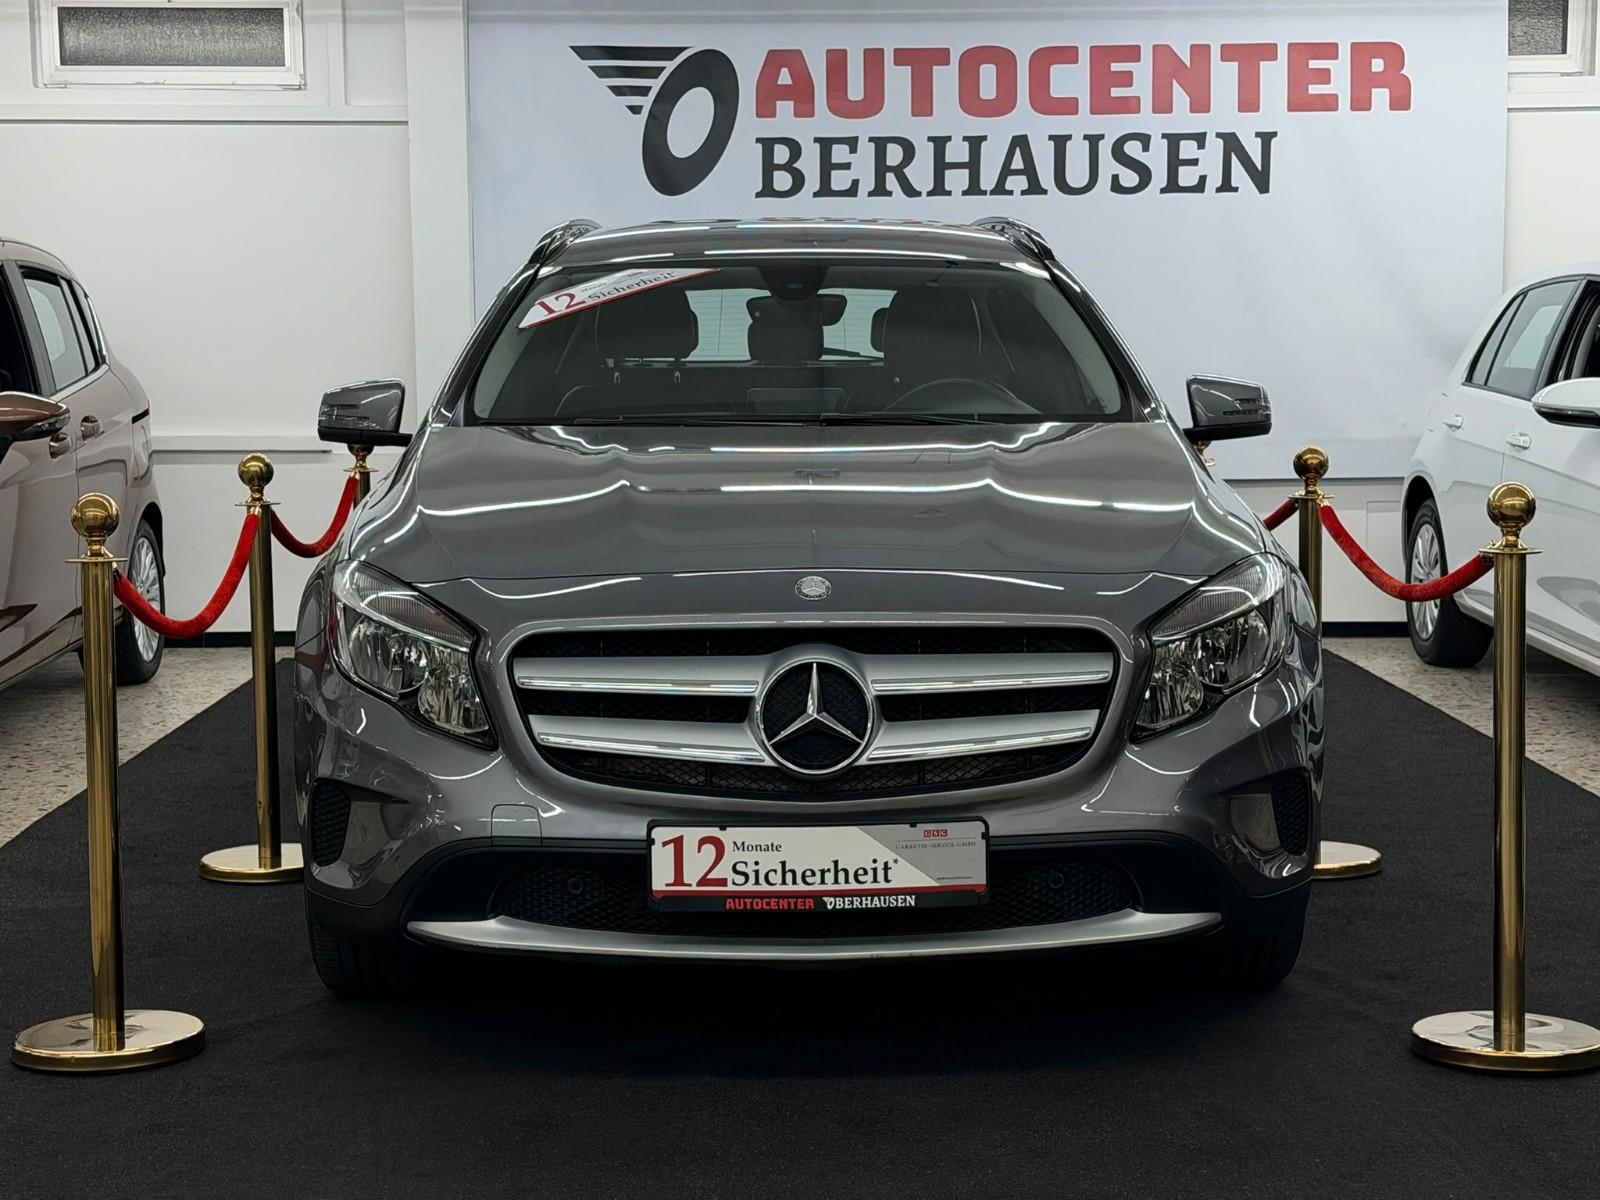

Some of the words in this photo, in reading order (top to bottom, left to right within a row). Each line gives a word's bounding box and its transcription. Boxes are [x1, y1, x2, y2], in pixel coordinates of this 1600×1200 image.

[755, 42, 1412, 119] AUTOCENTER
[537, 292, 586, 317] 12
[732, 841, 782, 852] Monate
[661, 834, 728, 887] 12
[726, 898, 814, 910] AUTOCENTER
